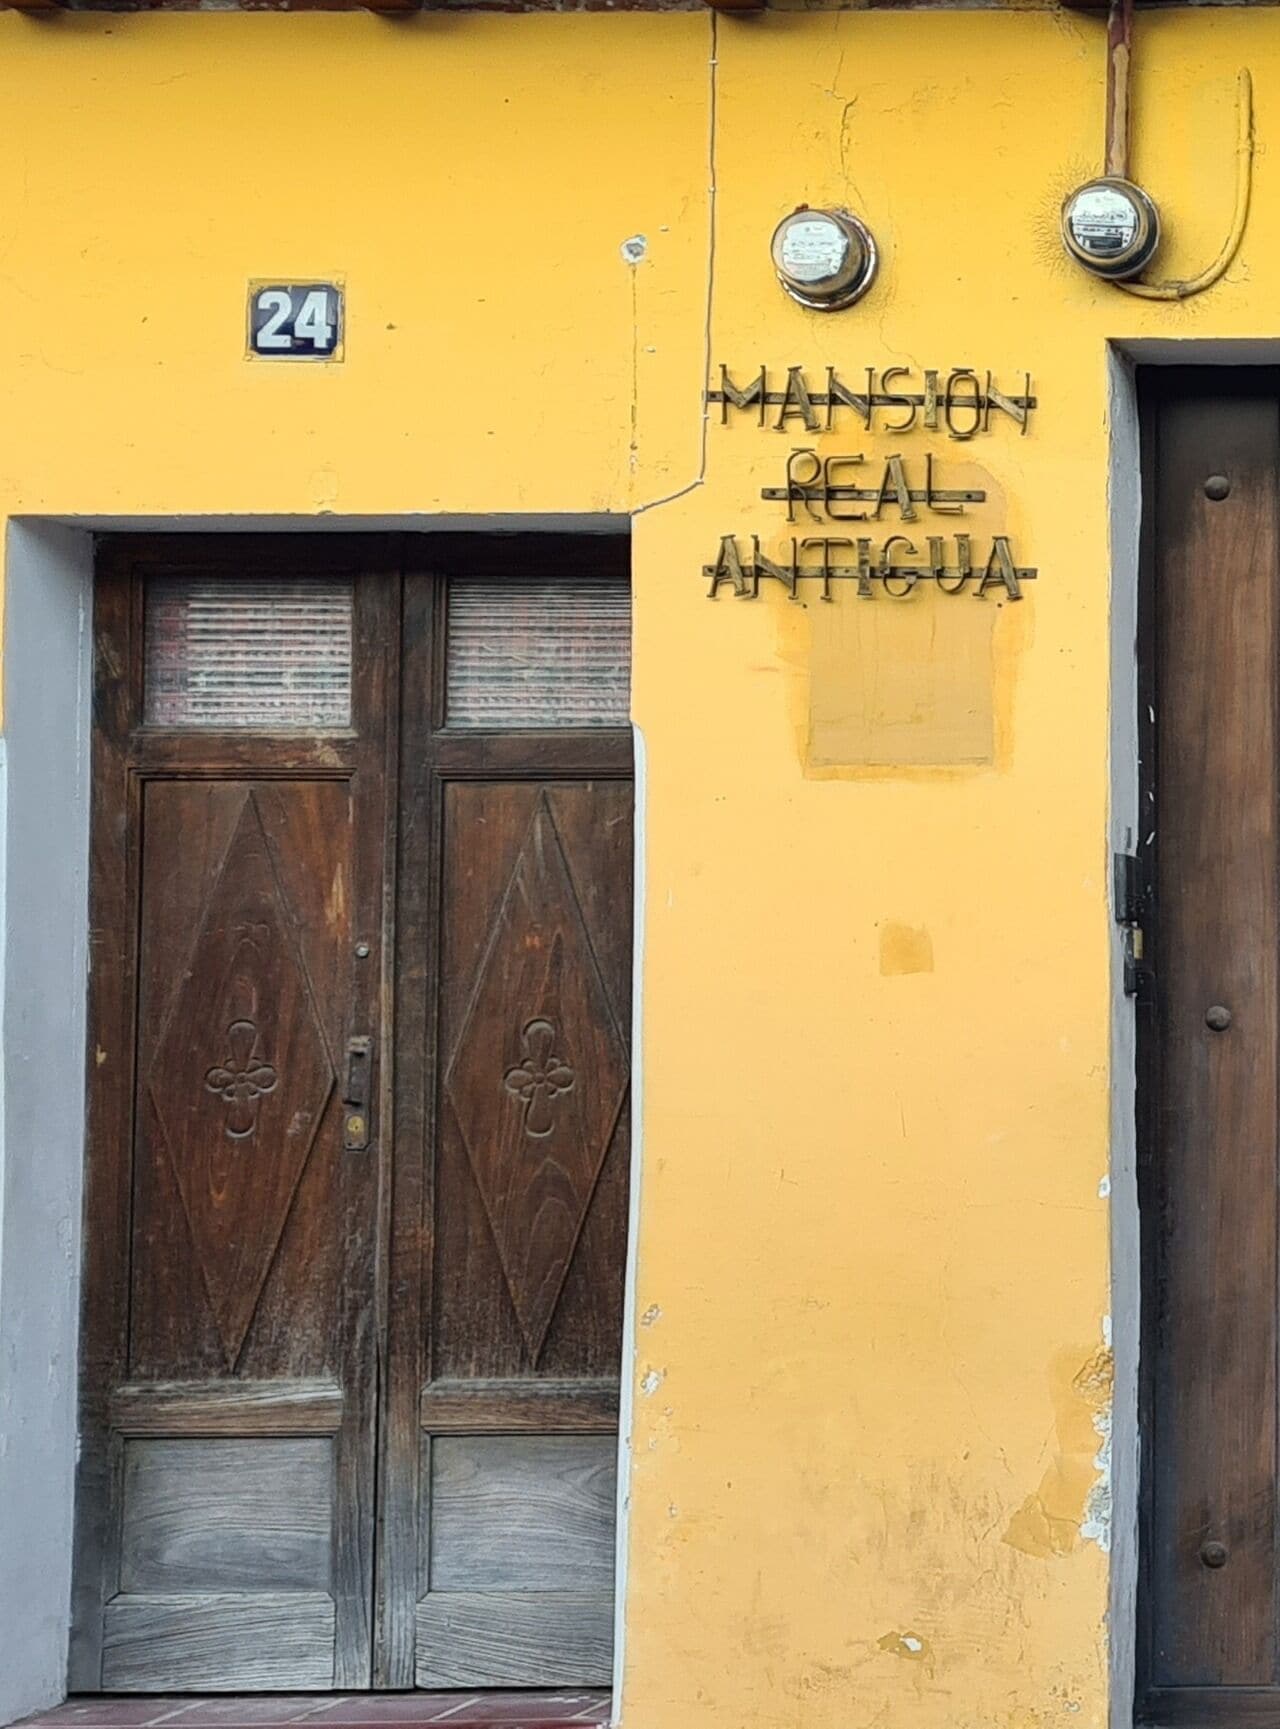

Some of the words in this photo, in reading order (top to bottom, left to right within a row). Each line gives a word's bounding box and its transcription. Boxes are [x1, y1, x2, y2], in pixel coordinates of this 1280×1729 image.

[257, 290, 332, 348] 24
[719, 364, 1031, 438] MANSION
[786, 448, 964, 523] REAL
[707, 534, 1022, 601] ANTIGUA
